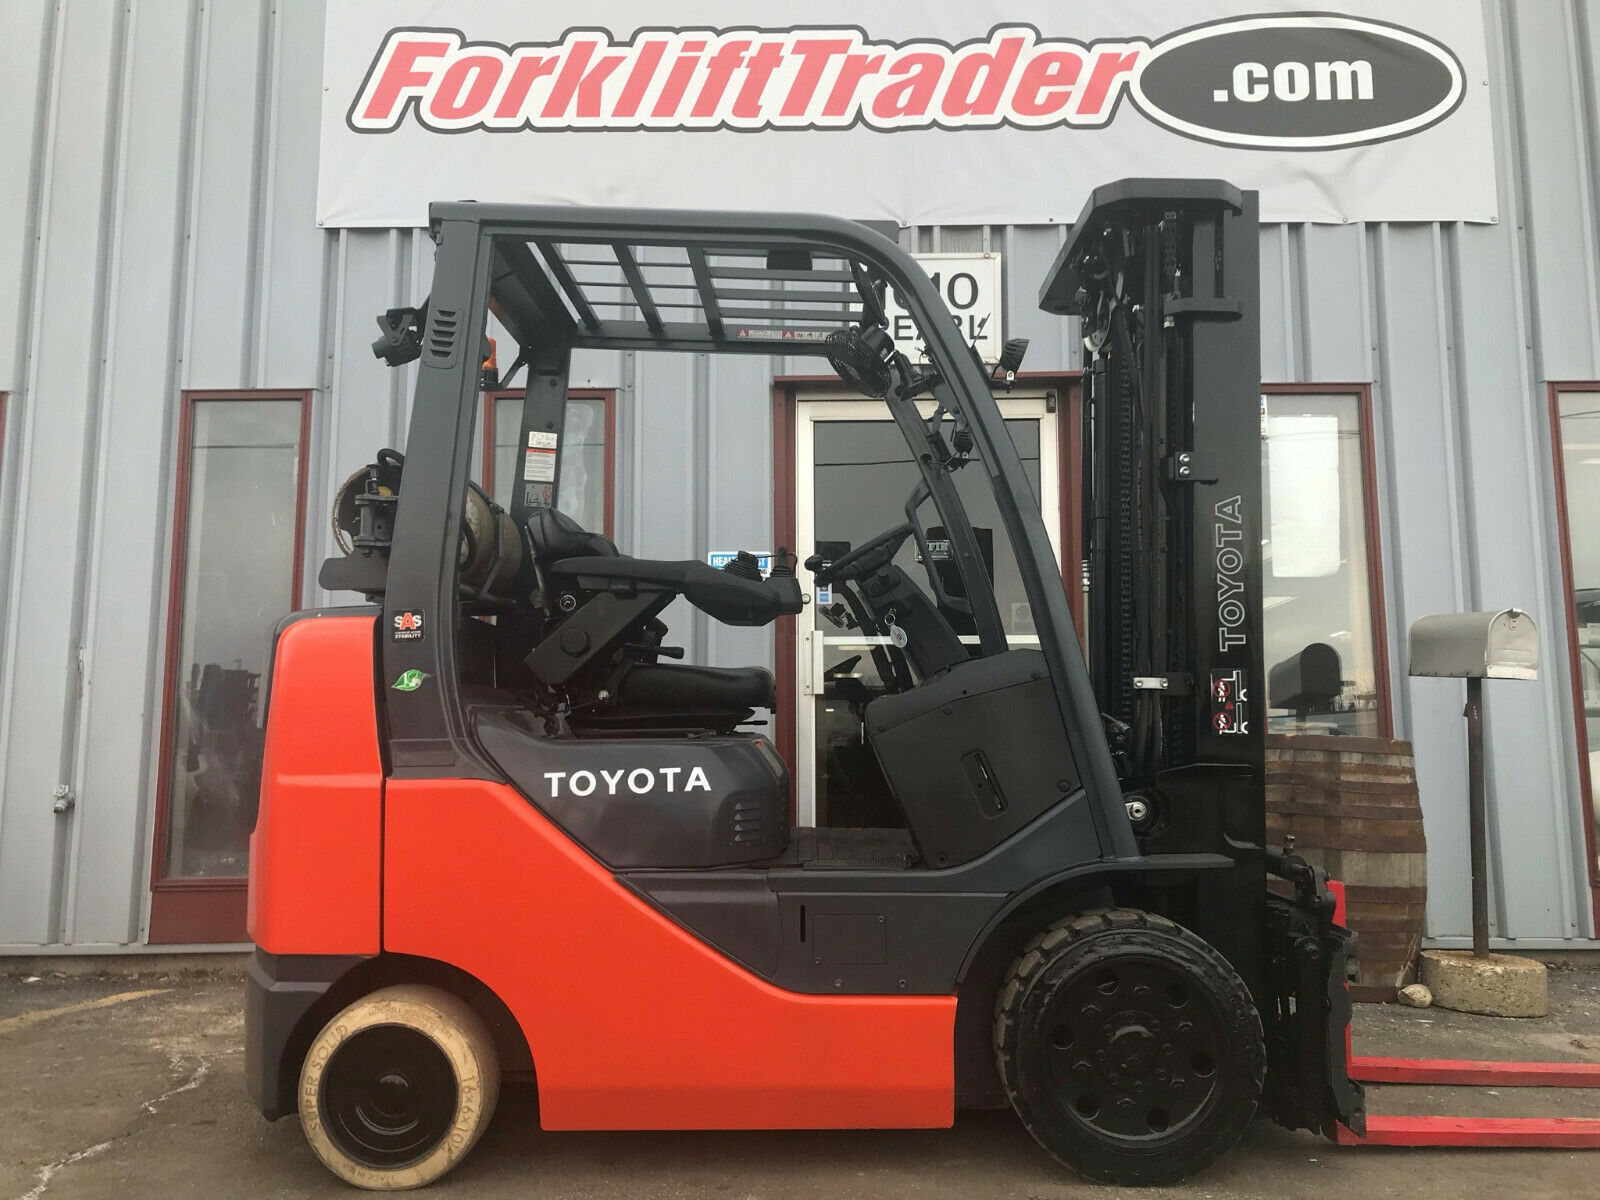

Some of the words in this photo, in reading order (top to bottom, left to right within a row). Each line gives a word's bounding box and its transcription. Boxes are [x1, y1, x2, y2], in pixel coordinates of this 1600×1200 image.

[363, 37, 1138, 119] ForkliftTrader
[1213, 59, 1373, 102] .com
[1214, 495, 1246, 652] TOYOTA
[394, 612, 422, 630] SAS
[543, 766, 712, 798] TOYOTA
[304, 1076, 319, 1131] SUPER
